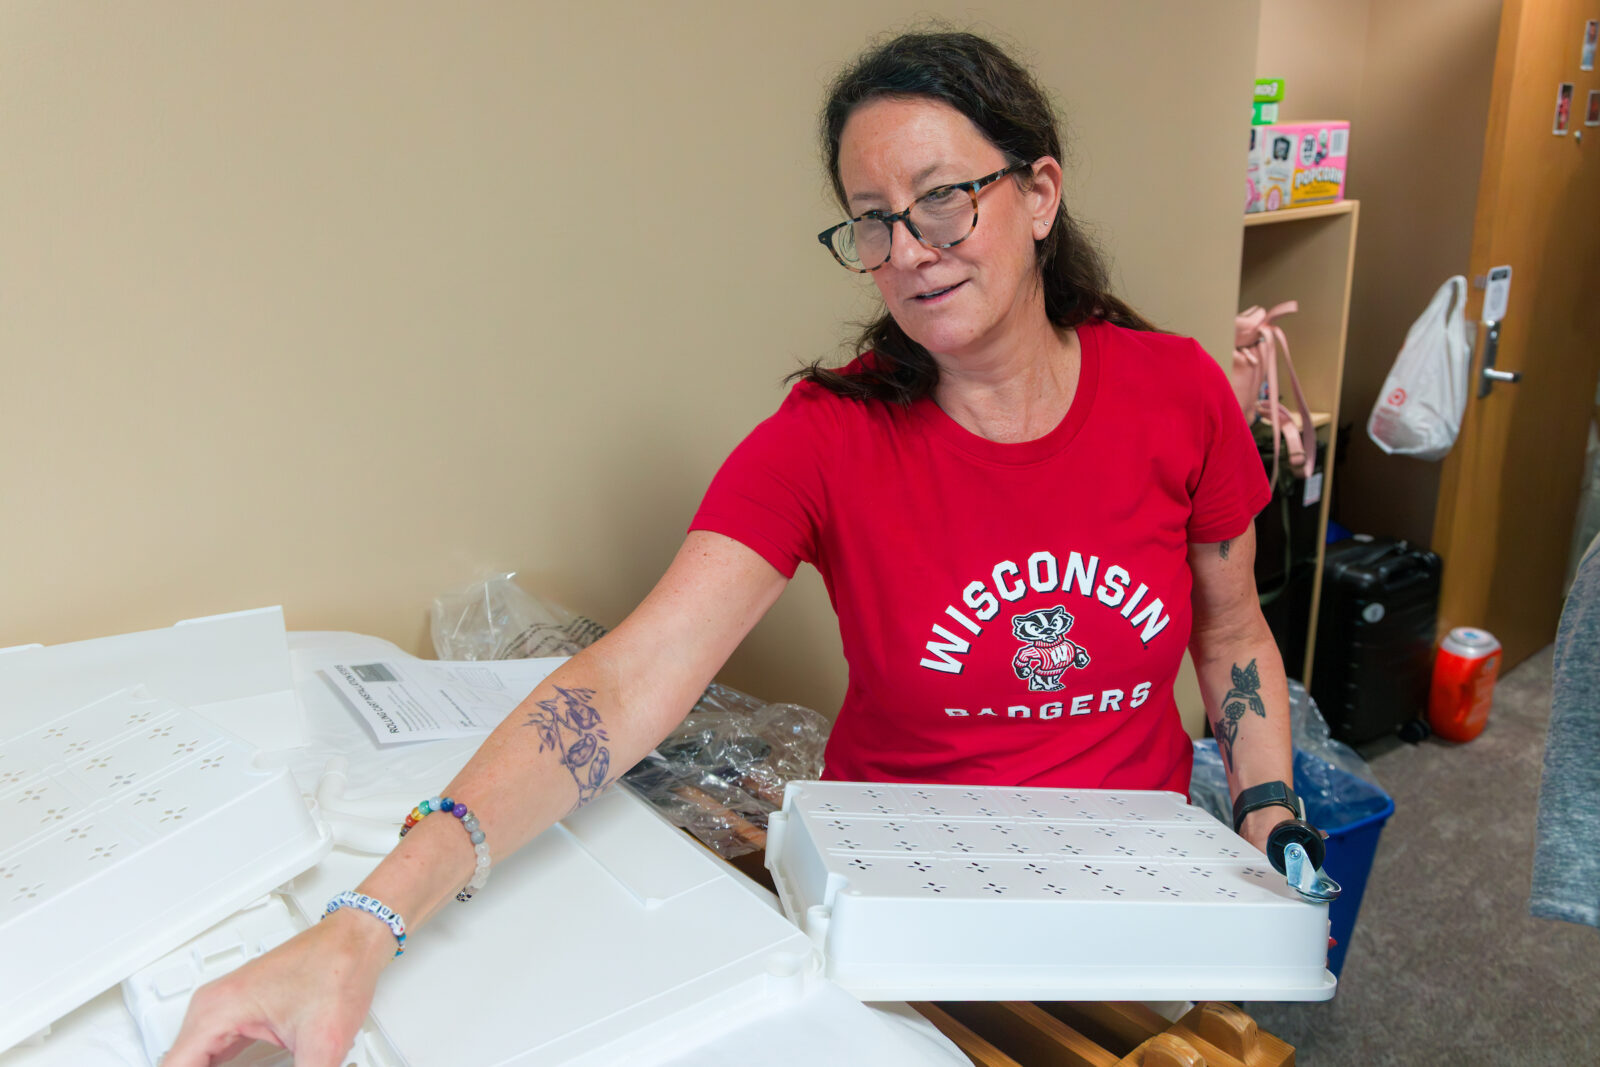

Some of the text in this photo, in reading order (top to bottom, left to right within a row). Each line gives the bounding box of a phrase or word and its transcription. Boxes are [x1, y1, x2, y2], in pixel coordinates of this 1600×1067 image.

[1295, 167, 1343, 190] POPCORN
[920, 551, 1170, 674] WISCONSIN
[1050, 645, 1068, 667] W
